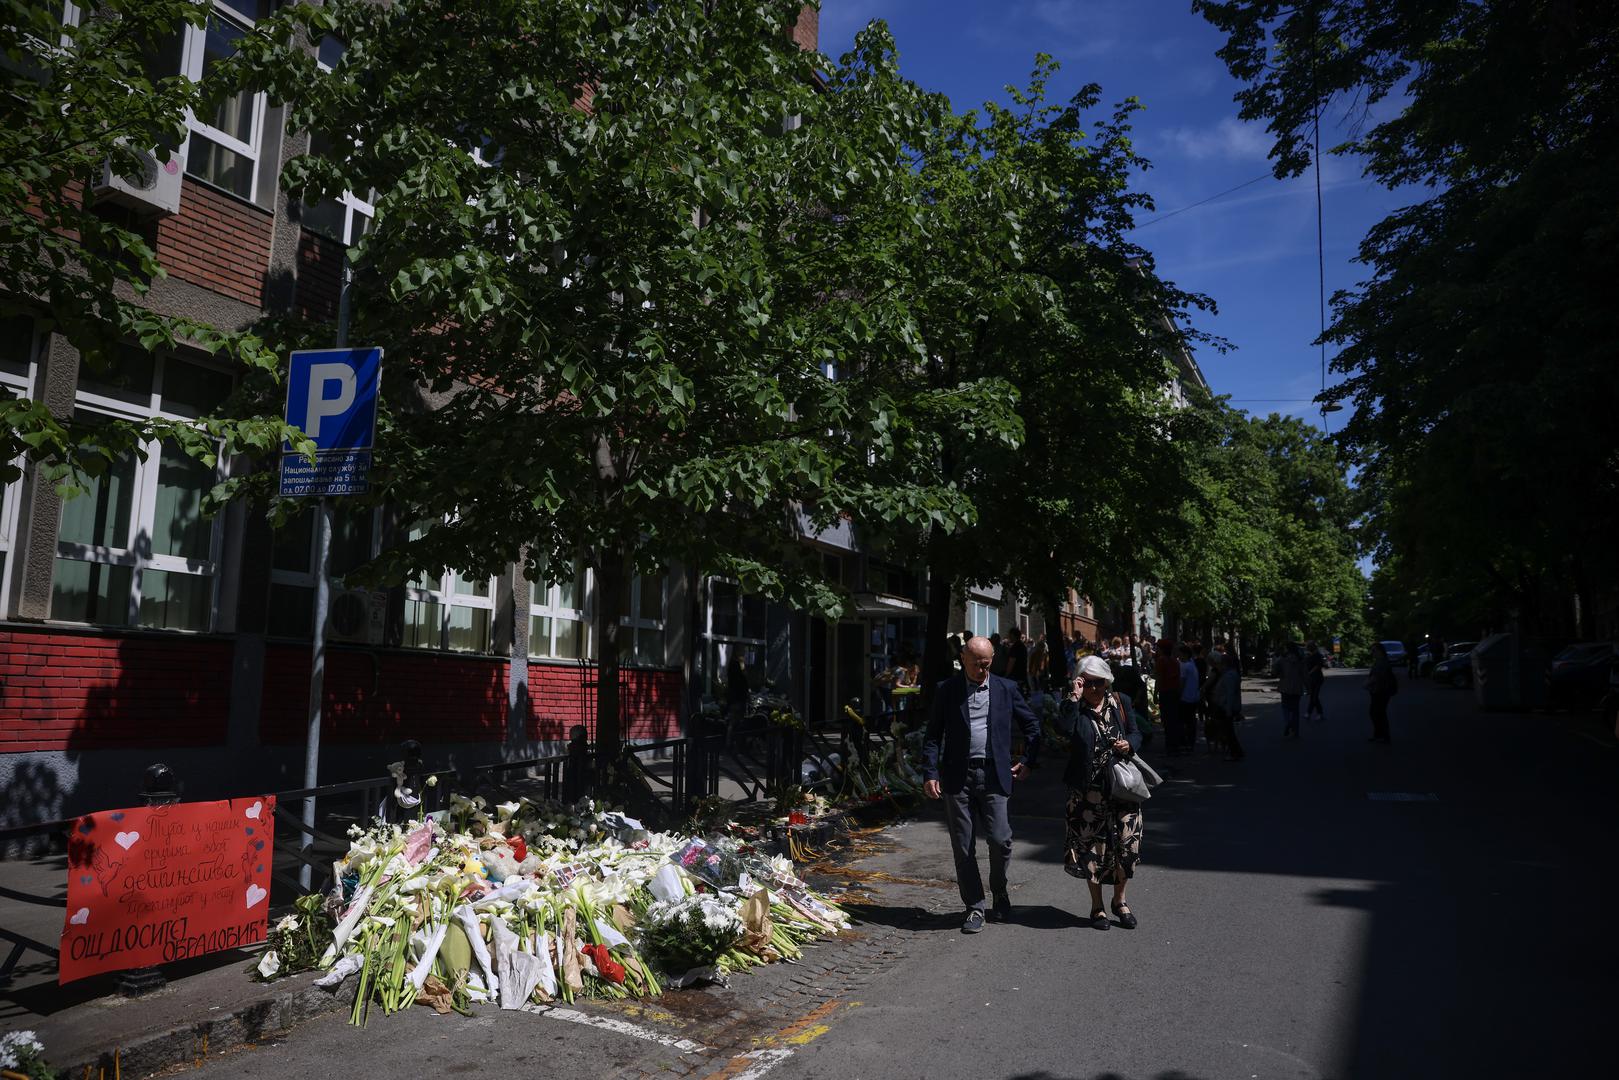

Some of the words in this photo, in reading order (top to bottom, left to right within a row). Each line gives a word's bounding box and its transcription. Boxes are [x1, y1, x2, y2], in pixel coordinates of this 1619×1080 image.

[305, 363, 357, 438] P
[284, 466, 326, 475] Националну
[328, 464, 355, 474] службу
[344, 474, 350, 482] 5
[294, 485, 315, 494] 07.00
[328, 484, 347, 492] 17.00
[192, 823, 201, 841] у
